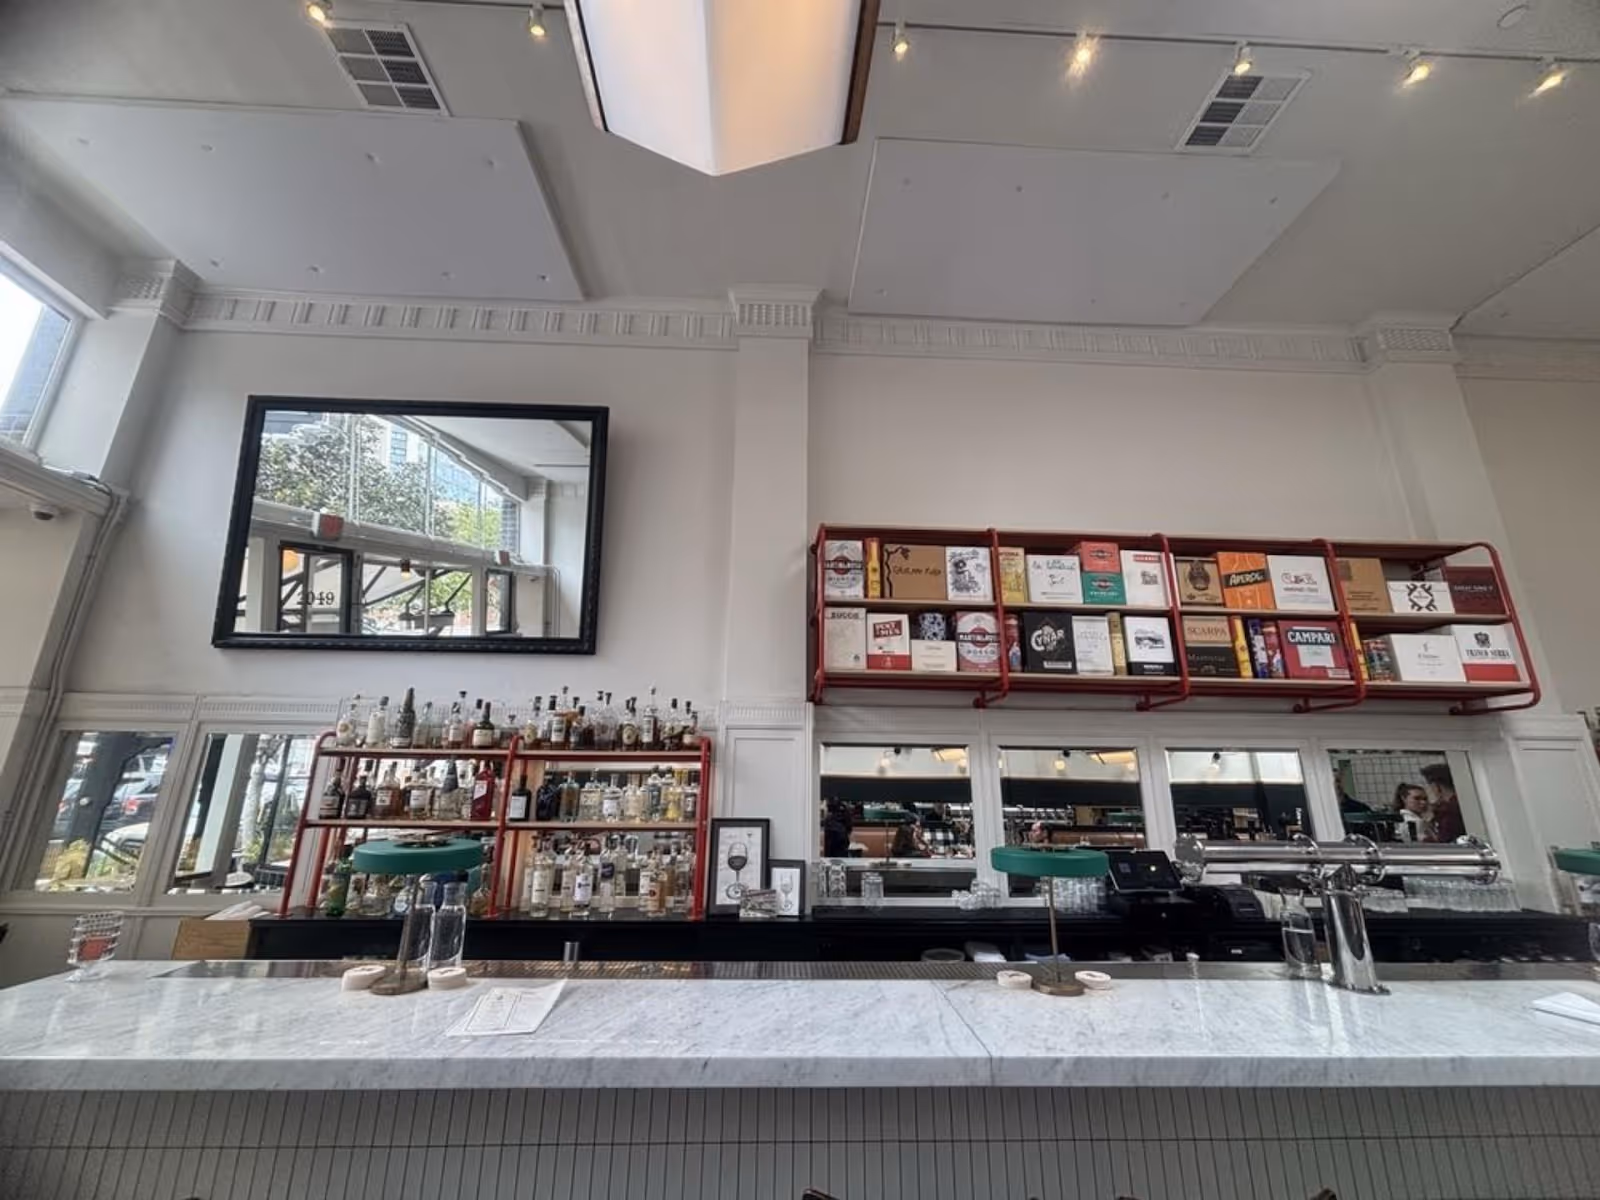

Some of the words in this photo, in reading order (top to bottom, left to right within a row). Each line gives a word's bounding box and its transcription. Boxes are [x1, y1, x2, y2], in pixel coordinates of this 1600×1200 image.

[1229, 572, 1265, 587] APEROL
[1031, 625, 1065, 651] CYNAR
[1187, 625, 1227, 638] SCARPA
[1287, 631, 1336, 644] CAMPARI
